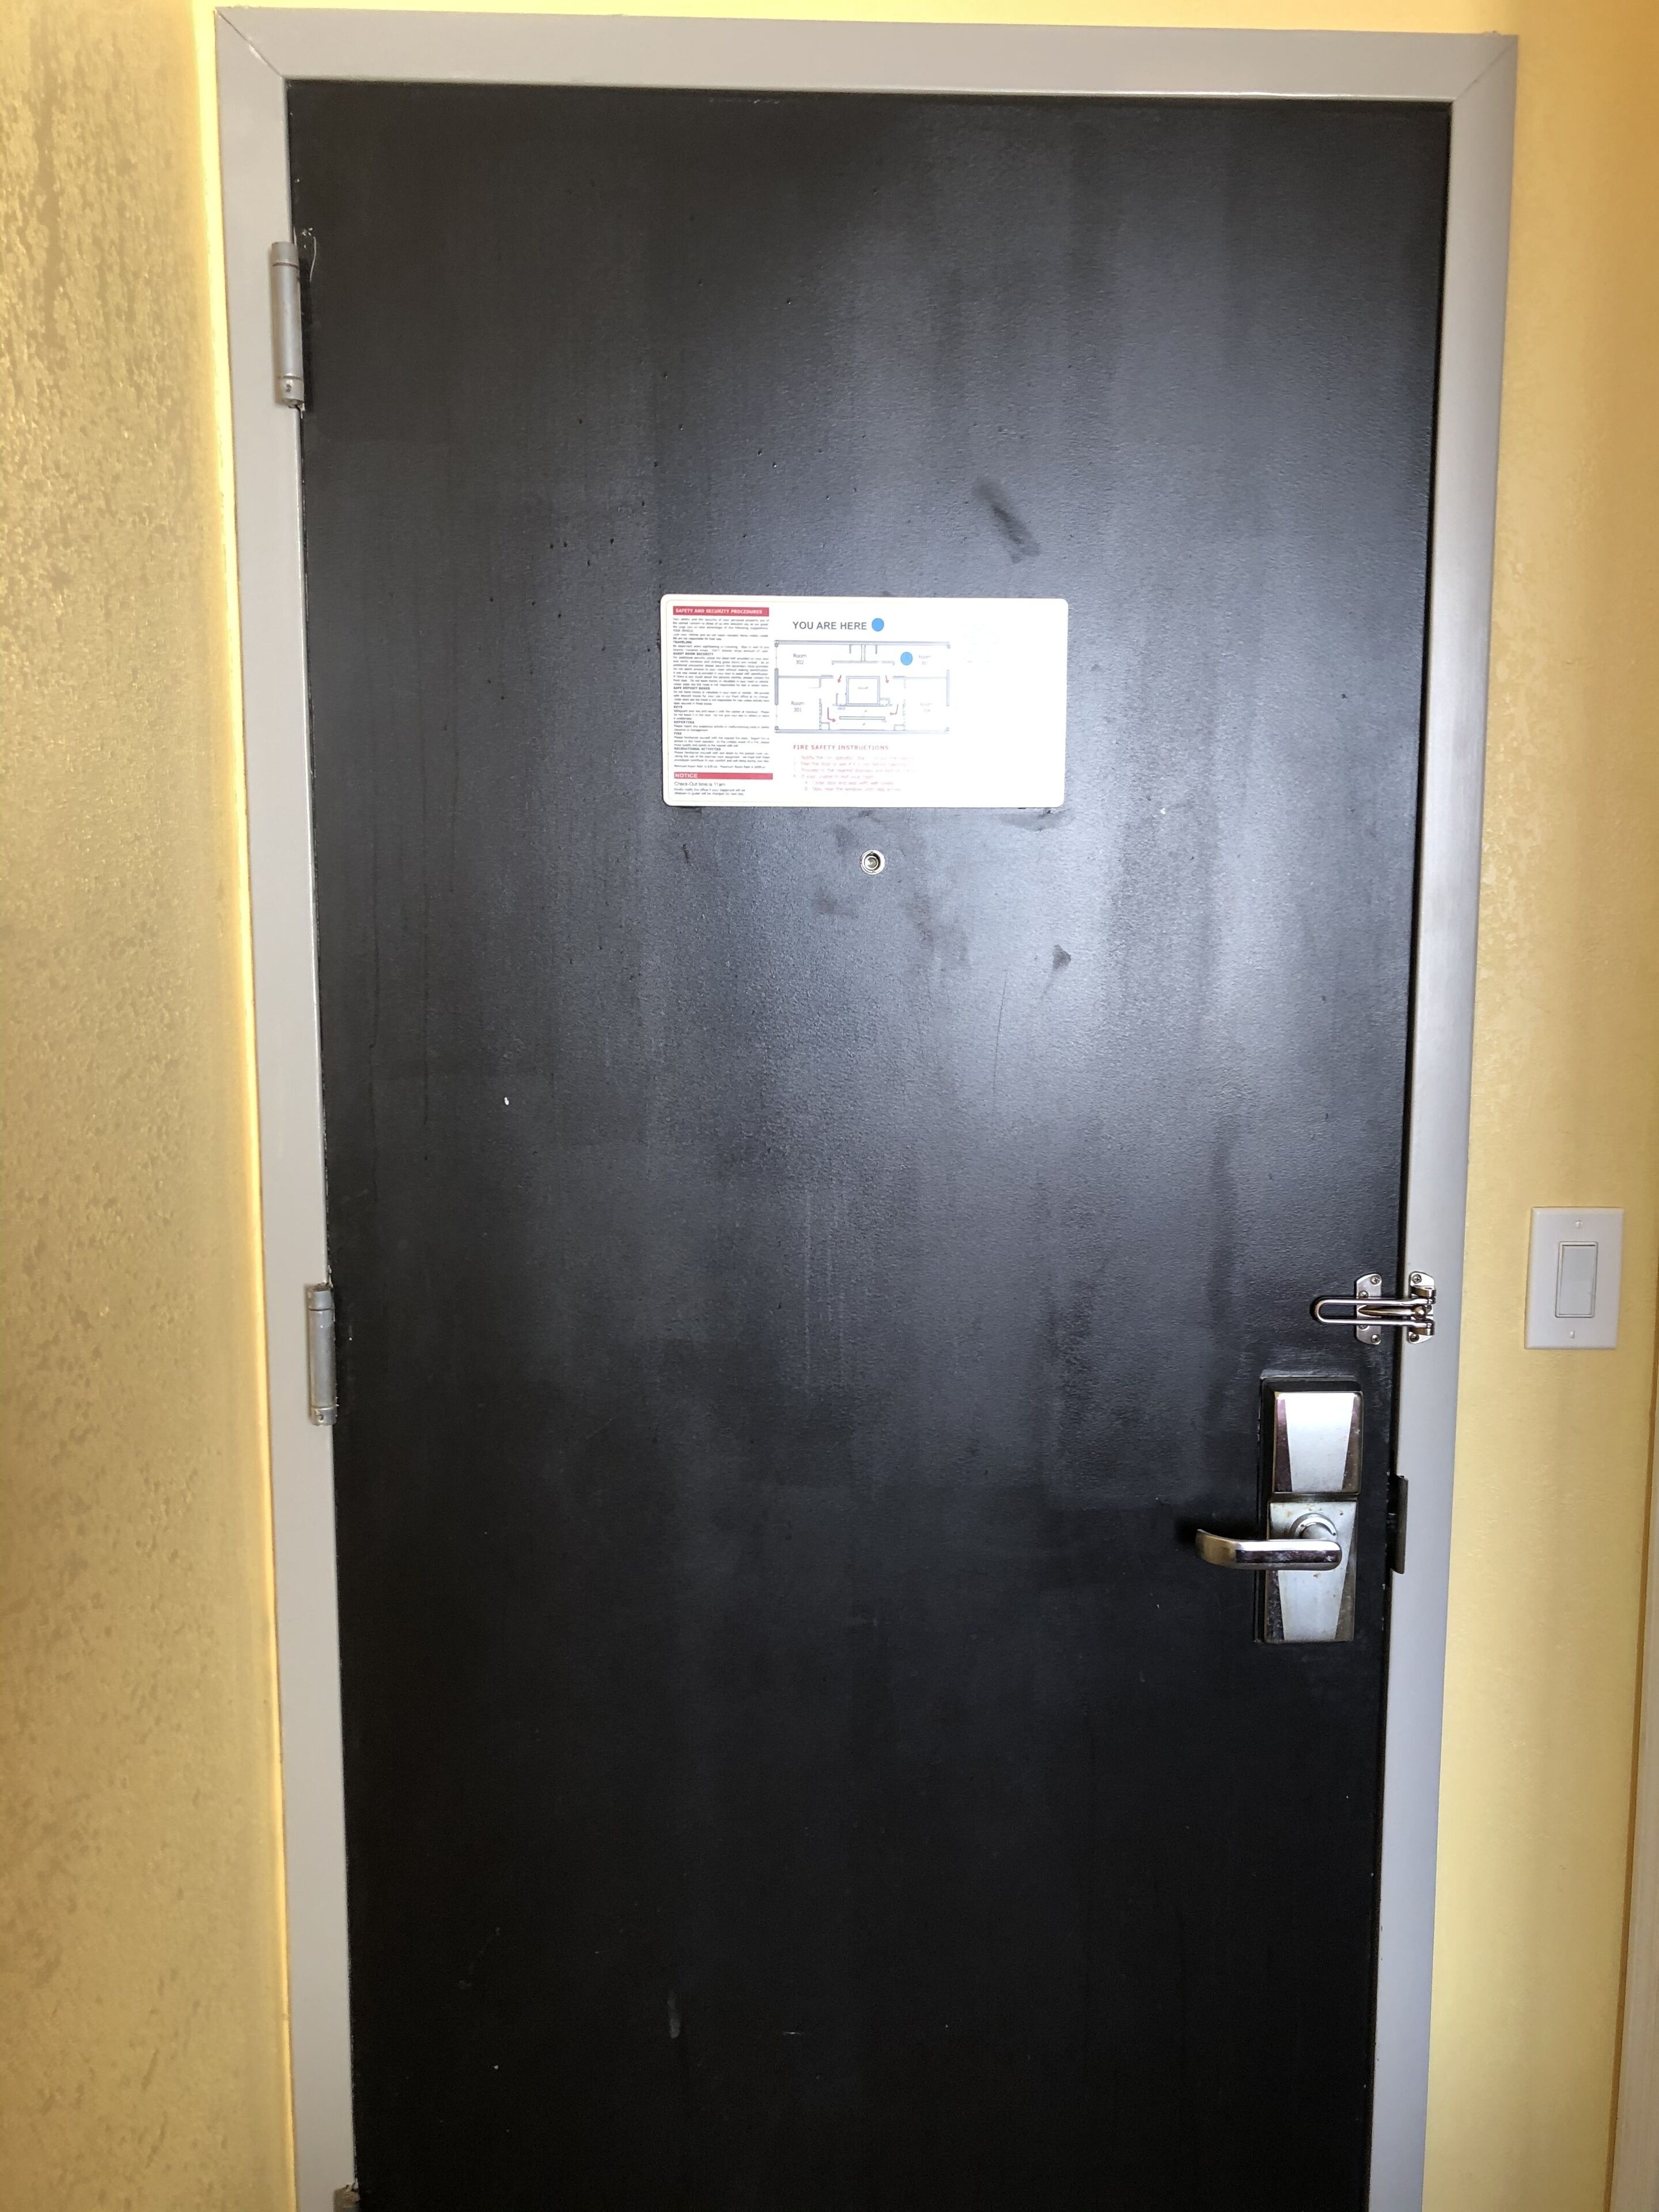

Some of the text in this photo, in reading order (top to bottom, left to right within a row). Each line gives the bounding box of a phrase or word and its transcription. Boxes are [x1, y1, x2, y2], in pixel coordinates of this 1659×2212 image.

[792, 621, 867, 630] YOU ARE HERE
